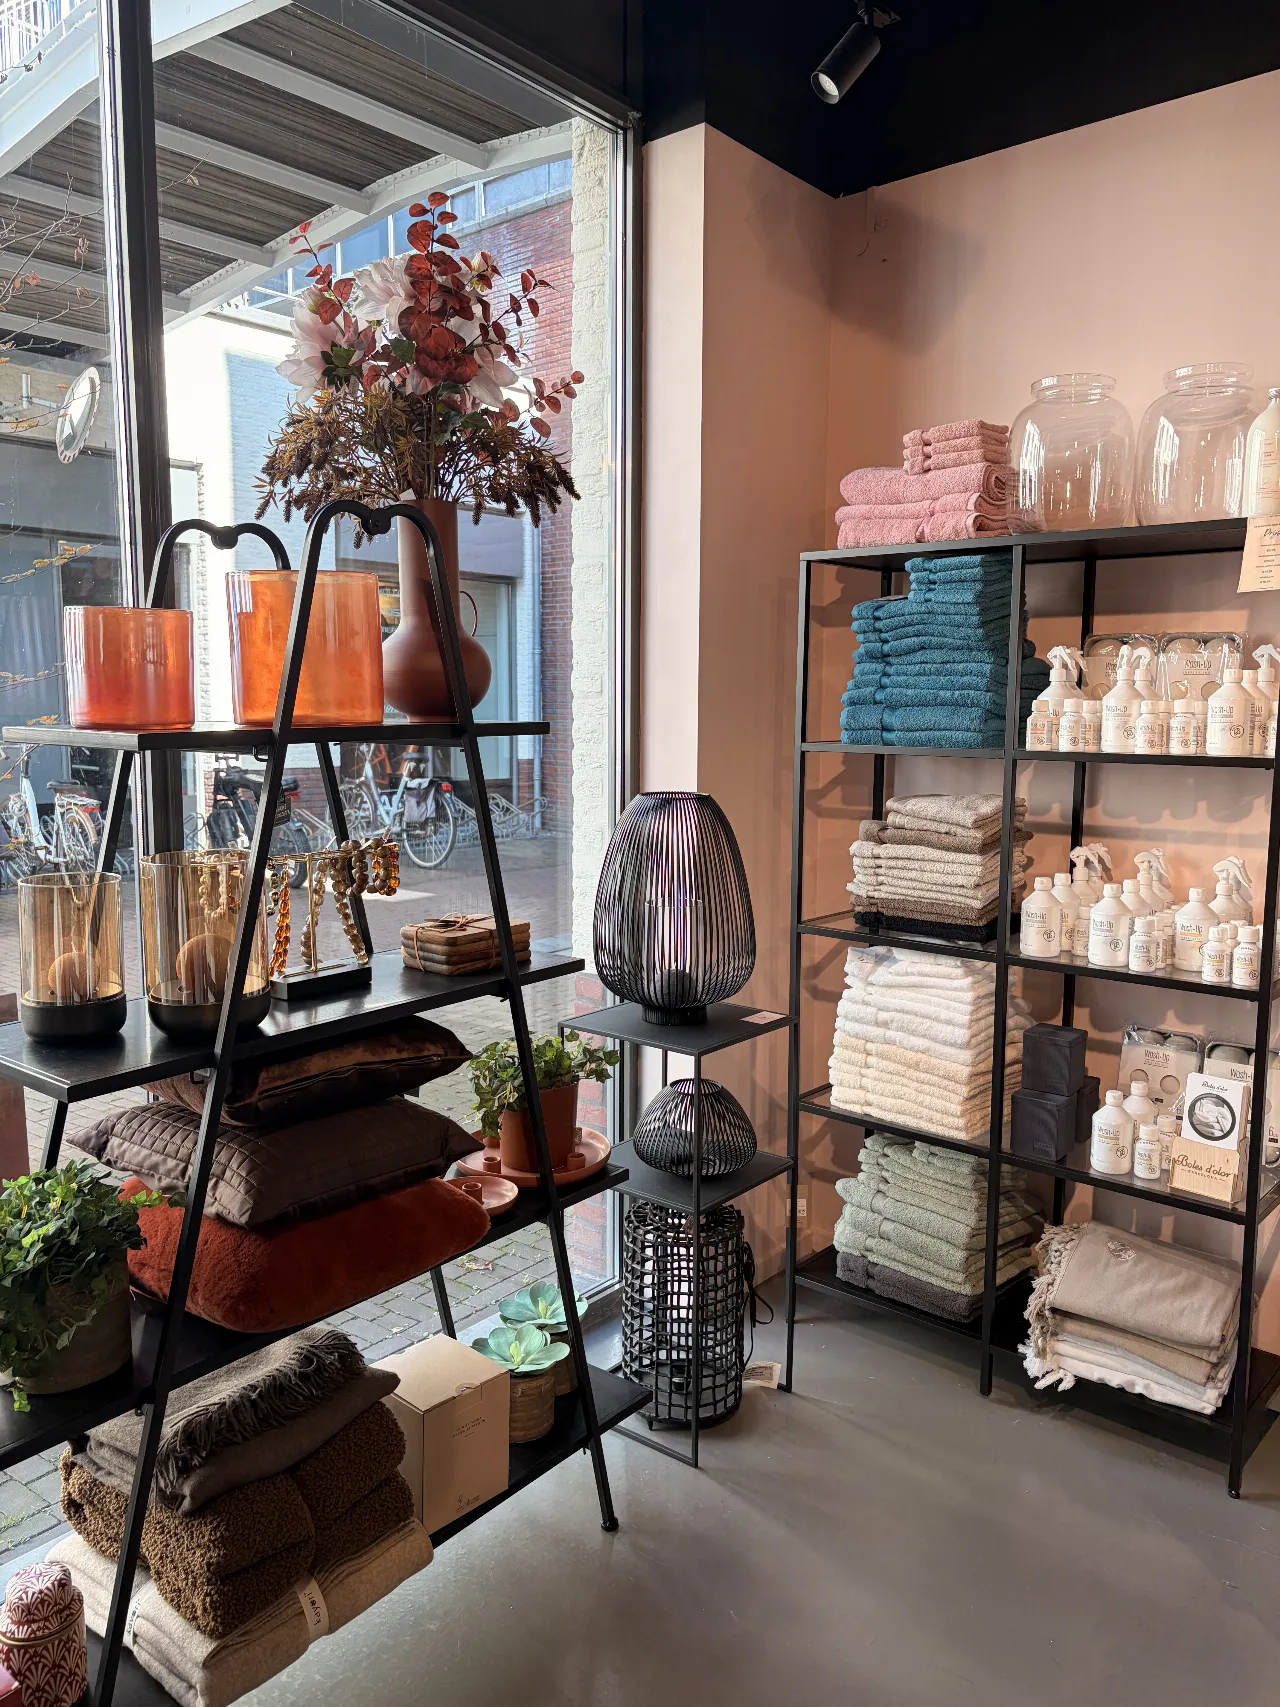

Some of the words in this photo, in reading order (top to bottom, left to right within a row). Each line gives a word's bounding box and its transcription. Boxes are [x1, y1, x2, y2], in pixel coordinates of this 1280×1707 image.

[1184, 659, 1212, 671] Wash-Up
[1092, 918, 1114, 931] Wash-Up
[1144, 1048, 1171, 1063] Wash-Up
[1175, 1154, 1203, 1172] Boles
[1205, 1163, 1232, 1179] d'olor
